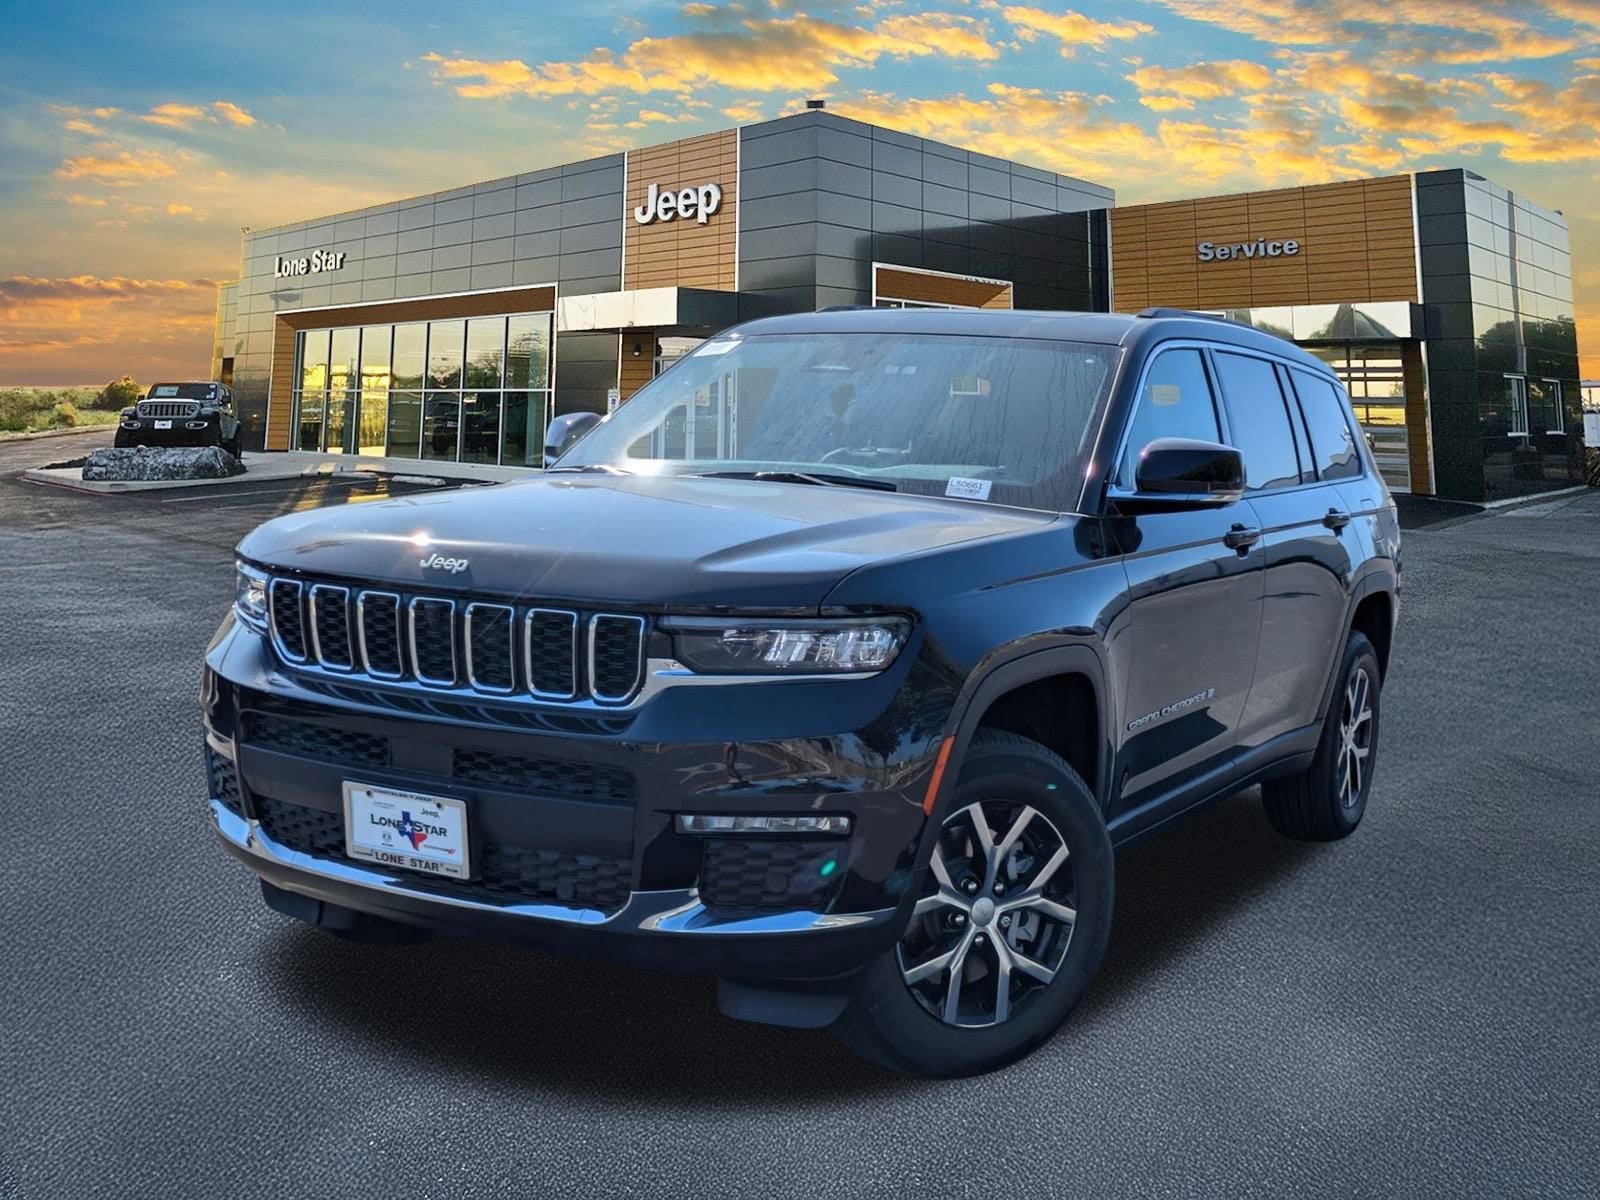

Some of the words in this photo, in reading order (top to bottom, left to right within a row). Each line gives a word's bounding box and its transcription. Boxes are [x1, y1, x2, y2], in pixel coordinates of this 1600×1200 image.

[634, 183, 722, 225] Jeep
[1198, 237, 1299, 261] Service
[274, 257, 310, 278] Lone
[311, 250, 346, 273] Star
[420, 553, 468, 574] Jeep
[1127, 711, 1160, 731] GRAND
[1160, 691, 1207, 716] CHEROKEE
[370, 813, 404, 831] LONE
[414, 820, 447, 837] STAR
